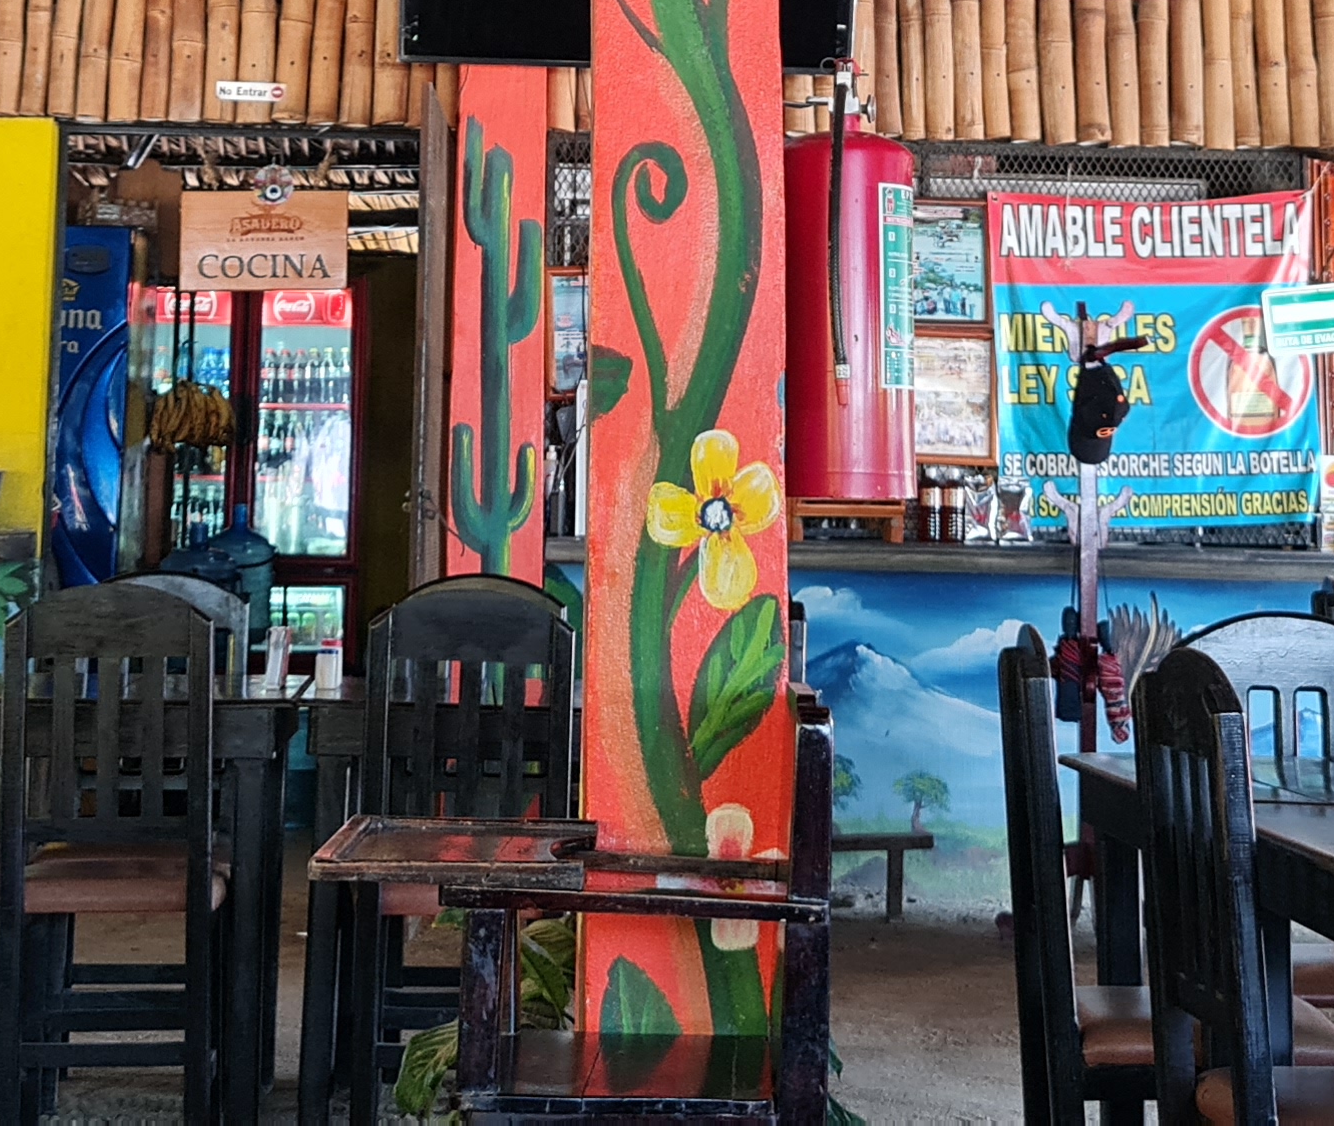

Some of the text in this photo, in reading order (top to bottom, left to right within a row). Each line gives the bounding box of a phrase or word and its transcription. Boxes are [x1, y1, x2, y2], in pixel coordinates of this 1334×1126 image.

[219, 86, 268, 97] No Entrar
[999, 201, 1302, 258] AMABLE CLIENTELA
[197, 253, 331, 279] COCINA
[1300, 334, 1314, 345] DE
[1002, 364, 1060, 405] LEY
[1003, 453, 1023, 476] SE
[1025, 453, 1078, 476] COBRA
[1173, 451, 1226, 476] SEGUN
[1227, 451, 1248, 476] LA
[1250, 449, 1317, 475] BOTELLA
[1130, 486, 1240, 518] COMPRENSIÓN
